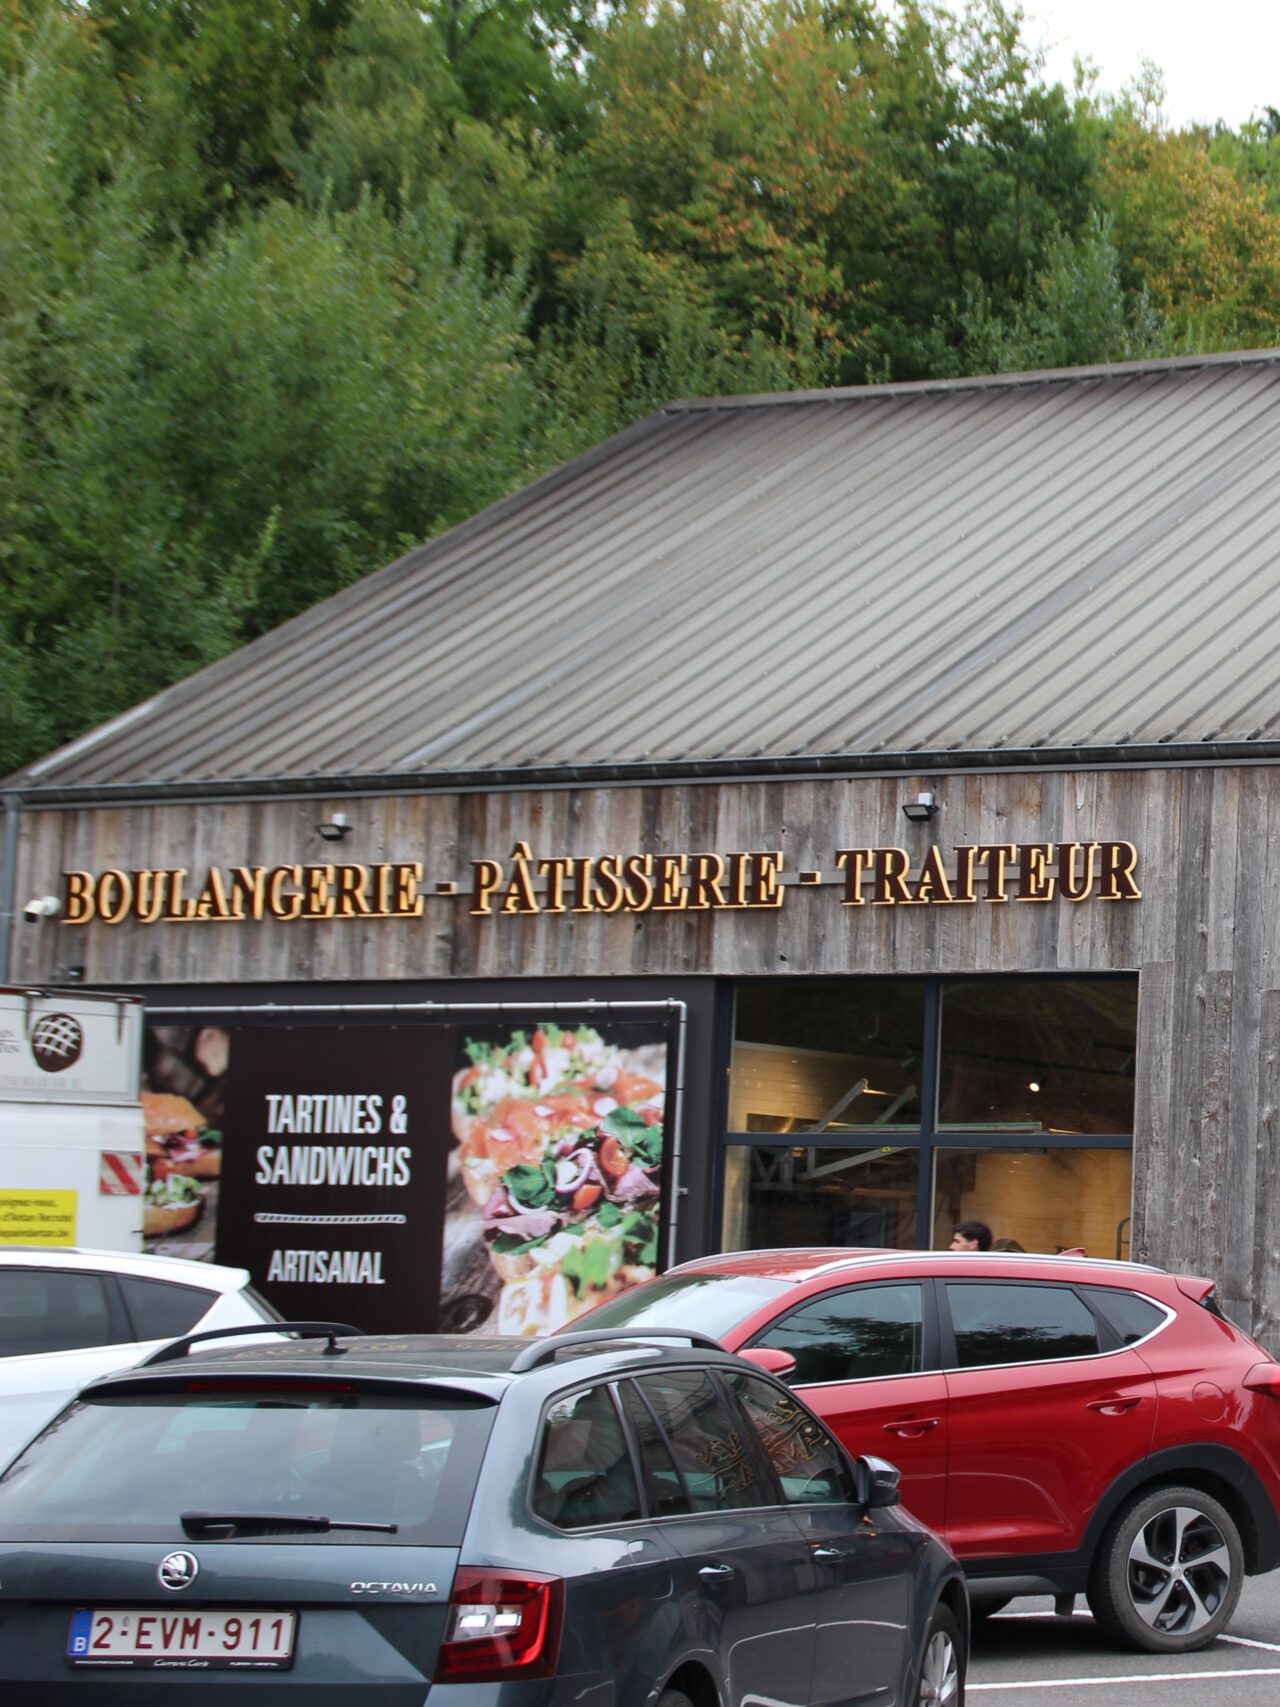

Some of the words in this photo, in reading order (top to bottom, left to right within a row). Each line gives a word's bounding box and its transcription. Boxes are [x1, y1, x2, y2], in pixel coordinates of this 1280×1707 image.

[61, 862, 424, 925] BOULANGERIE
[469, 840, 785, 915] PÂTISSERIE
[835, 840, 1142, 906] TRAITEUR
[265, 1094, 383, 1134] TARTINES
[389, 1094, 408, 1134] &
[255, 1145, 412, 1186] SANDWICHS
[267, 1249, 386, 1285] ARTISANAL
[350, 1581, 437, 1594] OCTAVIA
[74, 1636, 87, 1652] B
